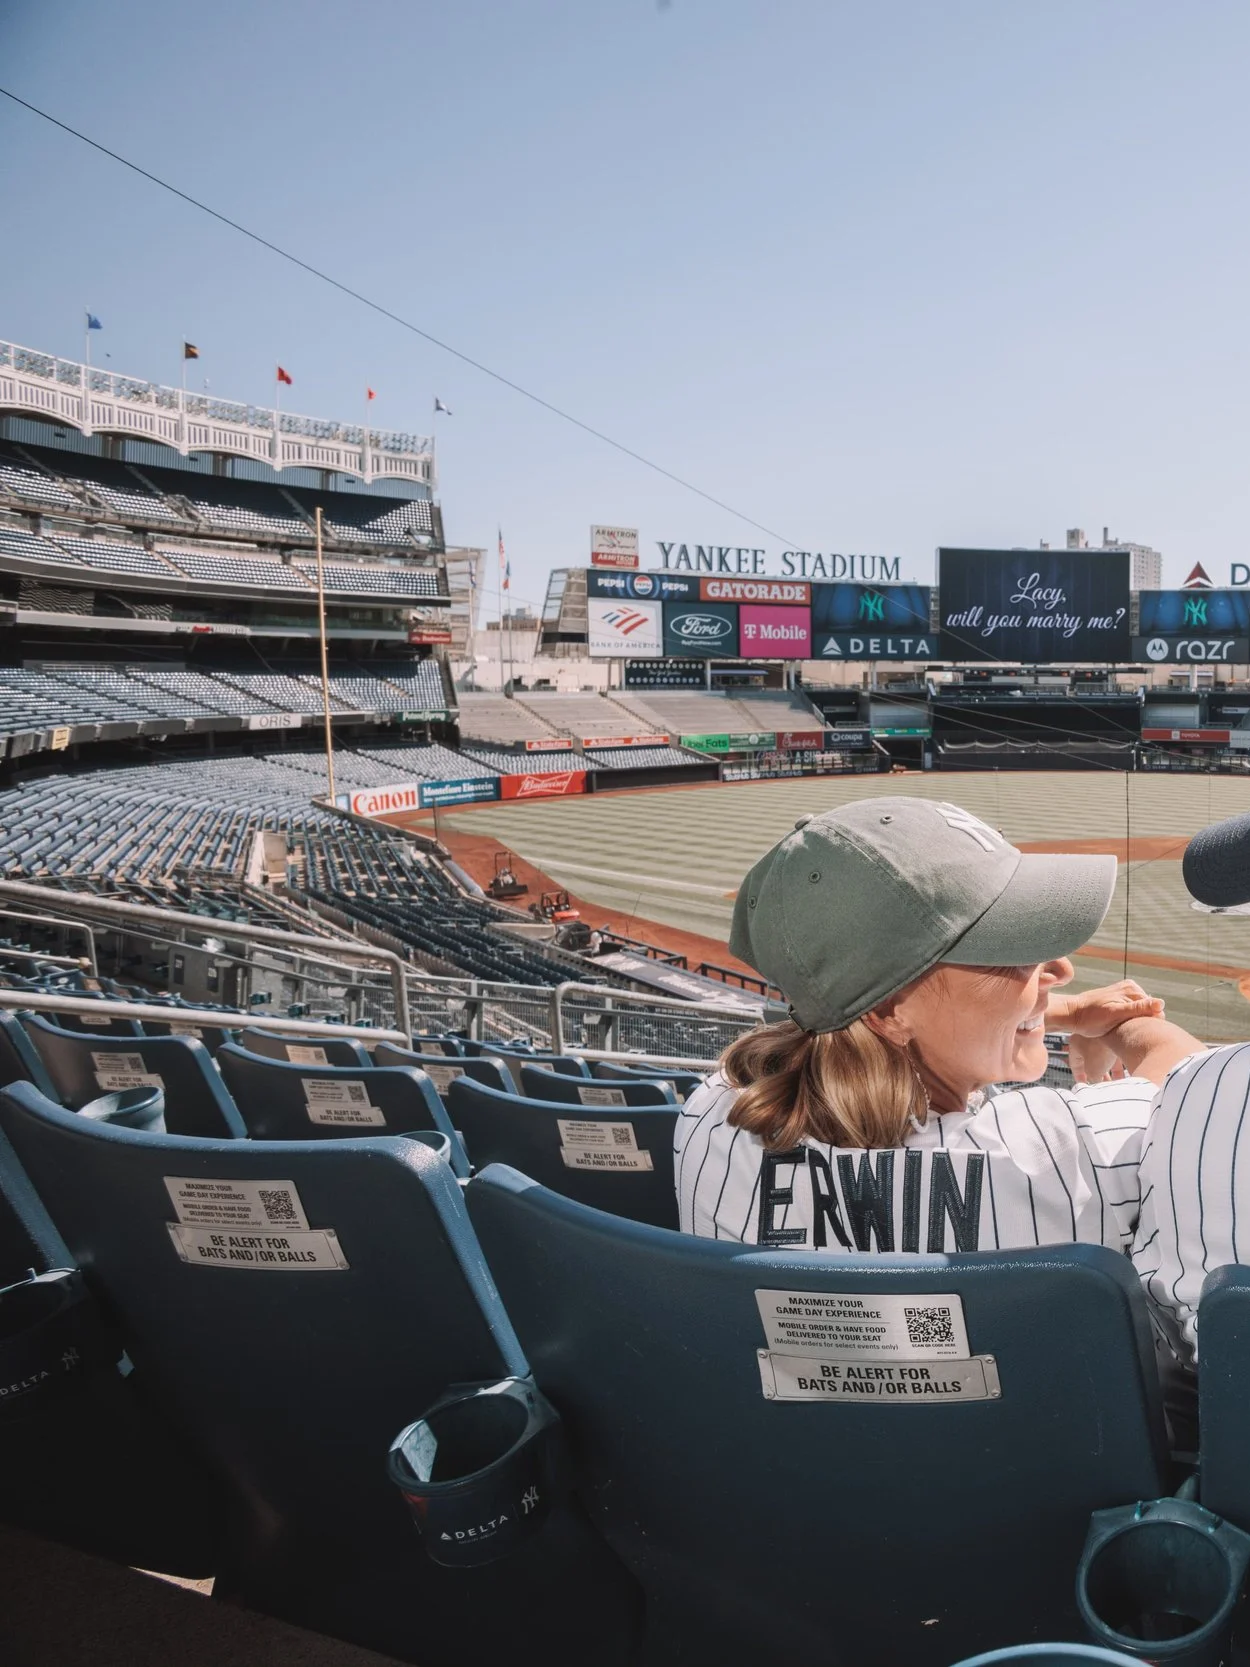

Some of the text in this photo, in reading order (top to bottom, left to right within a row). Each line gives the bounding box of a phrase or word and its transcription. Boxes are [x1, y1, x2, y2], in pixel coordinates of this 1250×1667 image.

[656, 541, 901, 581] YANKEE STADIUM
[597, 578, 625, 588] PEPSI
[662, 581, 689, 592] PEPSI
[706, 581, 806, 601] GATORADE
[1010, 572, 1067, 611] Lacy,
[681, 617, 721, 635] Ford
[946, 605, 1126, 638] will you marry me?
[759, 625, 807, 641] Mobile
[849, 638, 931, 655] DELTA
[1176, 641, 1236, 660] razr
[259, 715, 292, 728] ORIS
[705, 738, 728, 748] Eats
[840, 733, 864, 741] coupa
[523, 779, 570, 791] Budweiser
[352, 789, 417, 815] Canon
[757, 1146, 986, 1254] ERWIN
[210, 1235, 290, 1249] BE ALERT FOR
[198, 1246, 227, 1260] BATS
[279, 1250, 317, 1263] BALLS
[788, 1297, 864, 1308] MAXIMIZE YOUR
[776, 1306, 882, 1319] GAME DAY EXPERIENCE
[778, 1322, 807, 1331] MOBILE
[808, 1323, 834, 1332] ORDER
[843, 1325, 864, 1333] HAVE
[865, 1326, 886, 1334] FOOD
[786, 1330, 827, 1340] DELIVERED
[838, 1333, 861, 1341] YOUR
[862, 1334, 881, 1342] SEAT
[774, 1337, 799, 1345] (Mobile
[800, 1339, 824, 1347] orders
[825, 1340, 834, 1348] for
[881, 1343, 899, 1351] only)
[820, 1365, 930, 1380] BE ALERT FOR
[0, 1370, 49, 1396] DELTA
[797, 1378, 837, 1393] BATS
[909, 1381, 962, 1393] BALLS
[455, 1514, 509, 1539] DELTA
